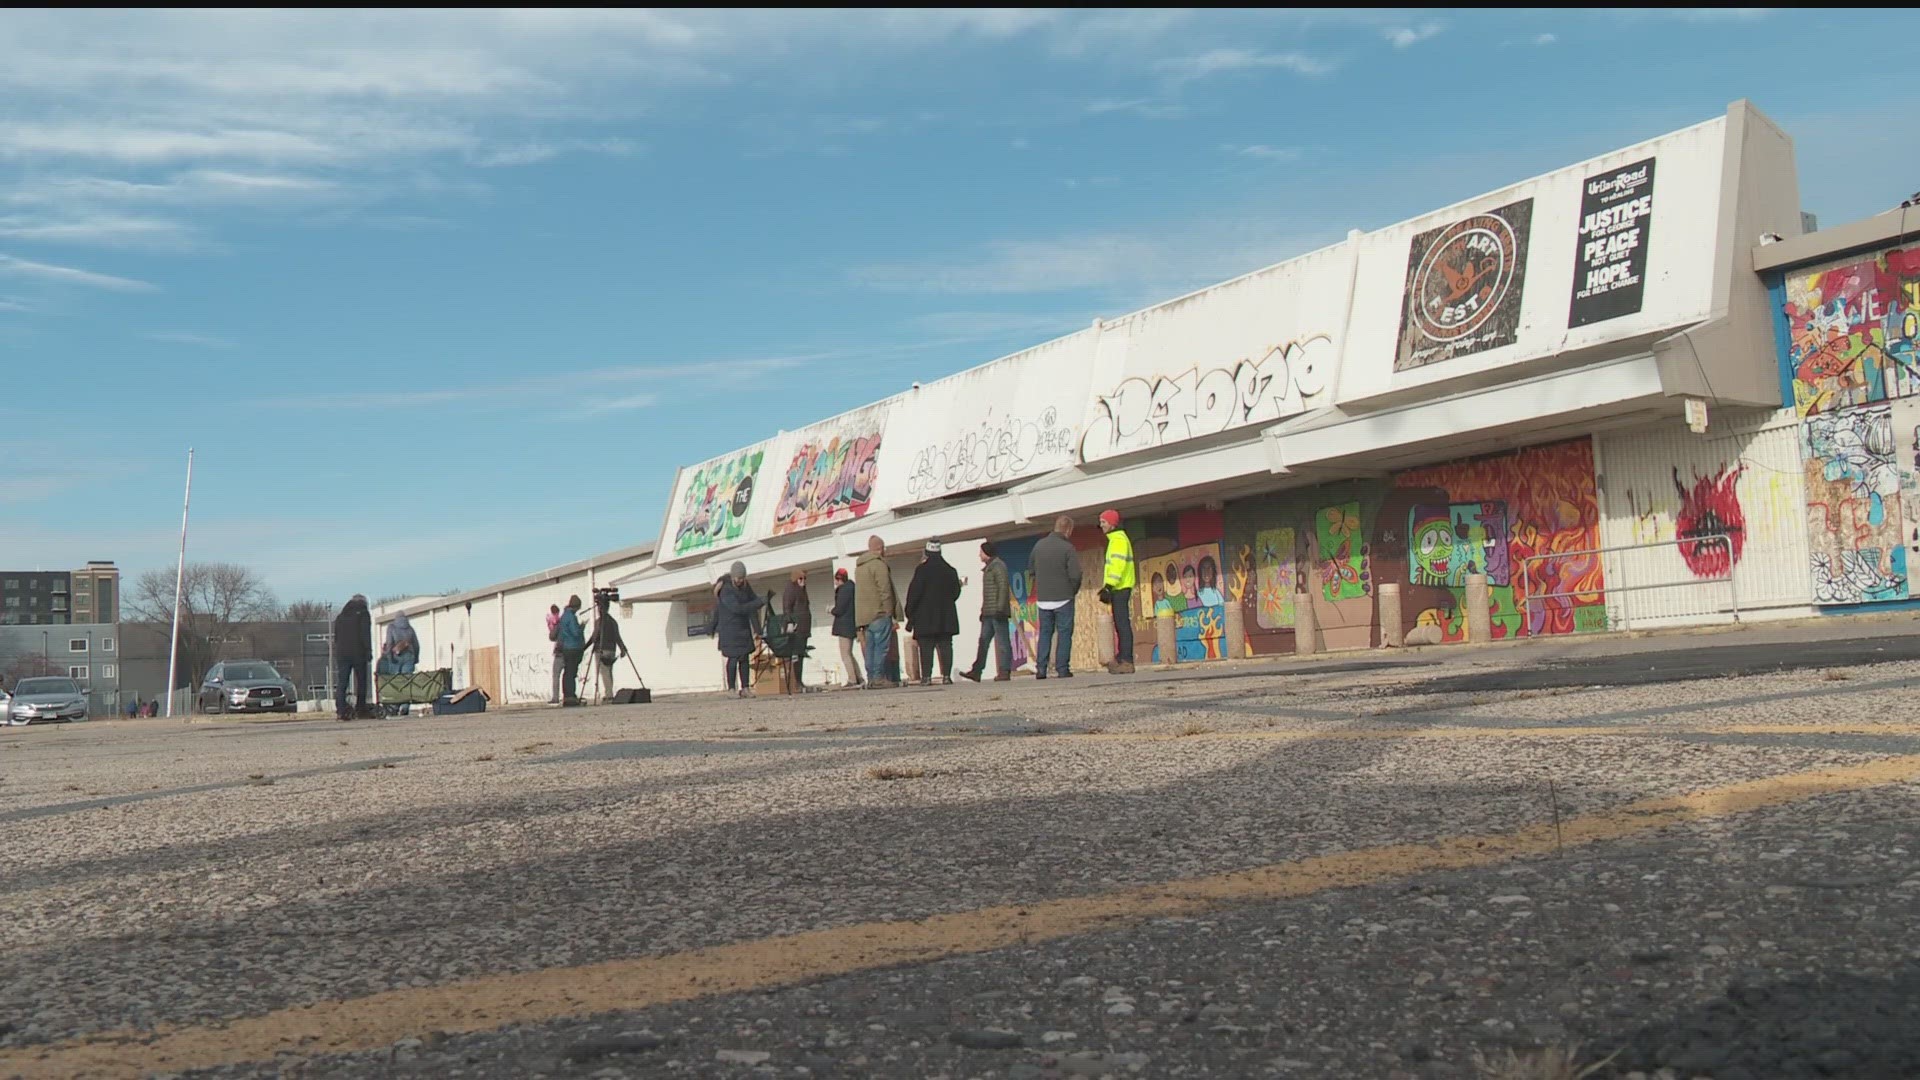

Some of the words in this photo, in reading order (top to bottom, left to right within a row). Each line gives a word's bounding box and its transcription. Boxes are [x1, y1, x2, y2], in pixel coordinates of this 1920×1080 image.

[1579, 194, 1652, 234] JUSTICE
[1591, 229, 1606, 239] FOR
[1607, 217, 1636, 234] GEORGE
[1466, 234, 1498, 256] ART
[1584, 228, 1640, 262] PEACE
[1591, 256, 1608, 267] NOT
[1609, 249, 1631, 262] QUIET
[1586, 260, 1632, 289] HOPE
[1576, 289, 1591, 299] FOR
[1592, 285, 1609, 295] REAL
[1610, 275, 1640, 290] CHANGE
[735, 487, 751, 504] THE
